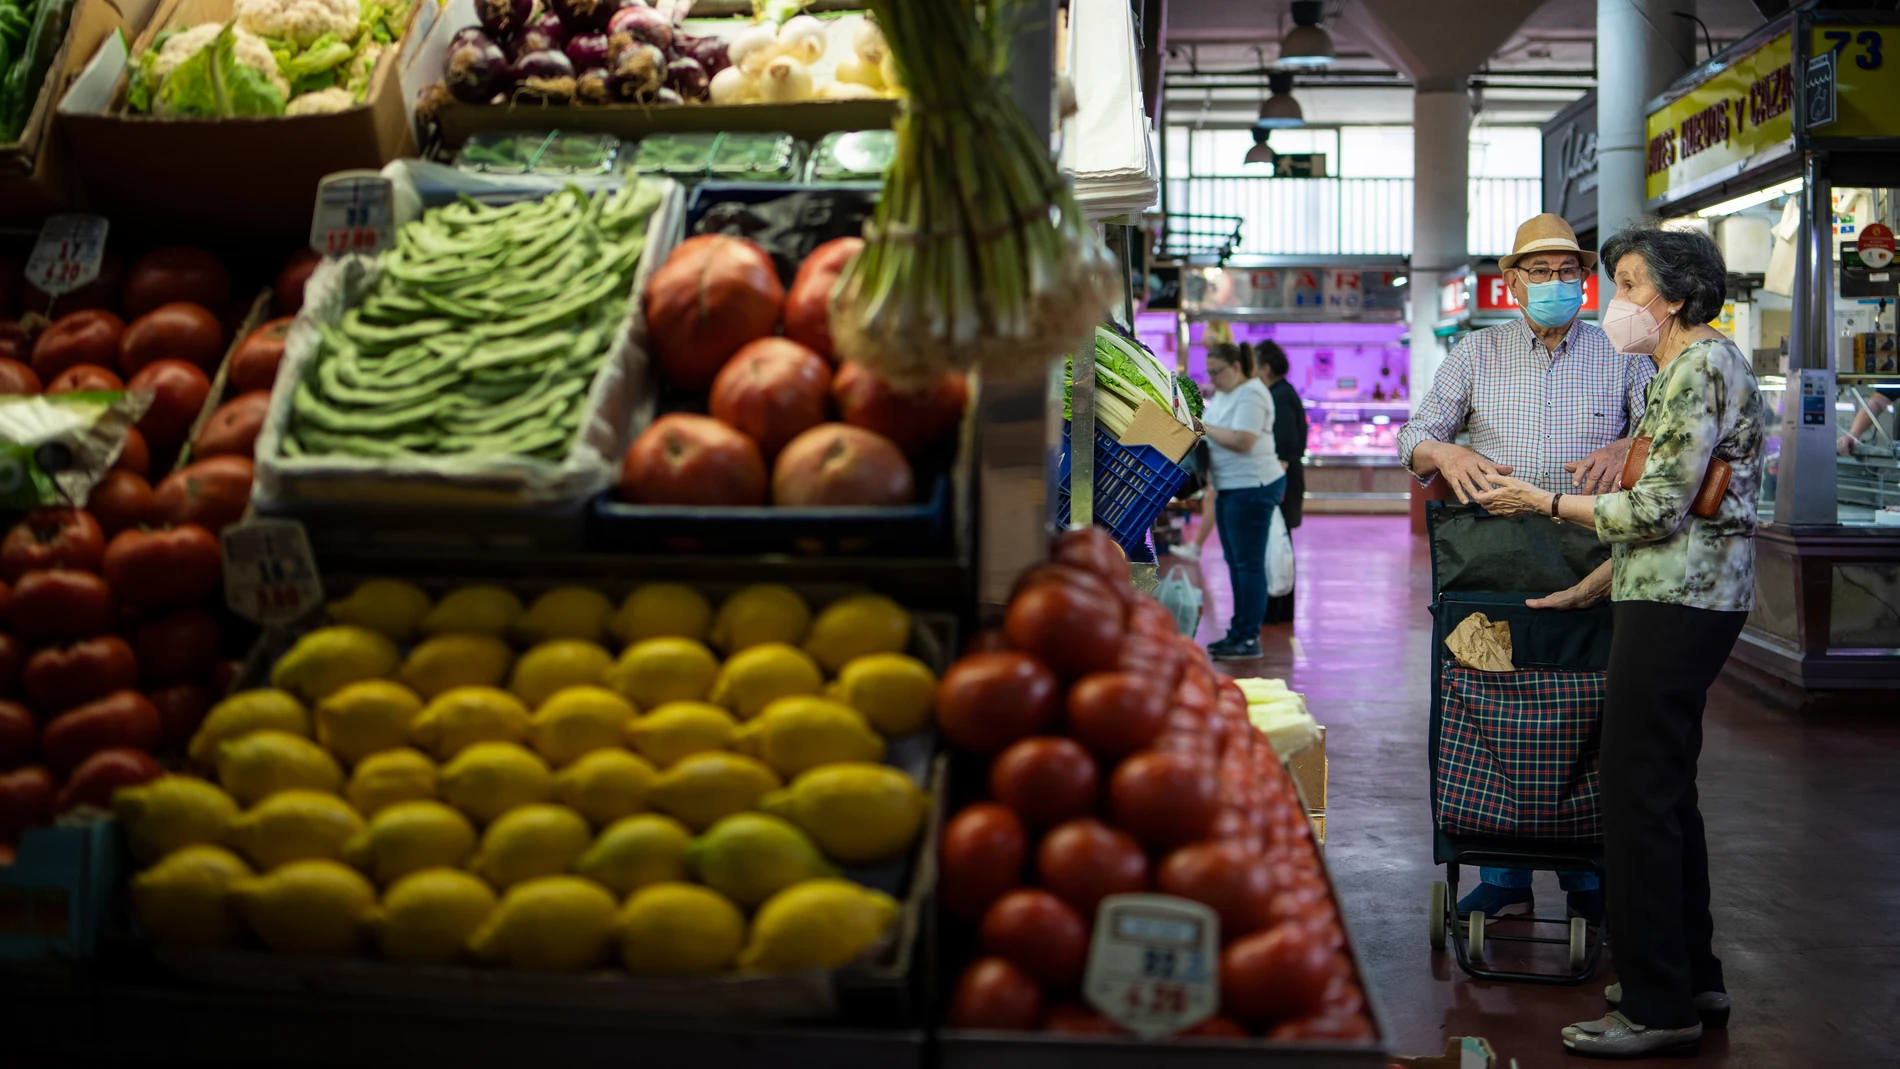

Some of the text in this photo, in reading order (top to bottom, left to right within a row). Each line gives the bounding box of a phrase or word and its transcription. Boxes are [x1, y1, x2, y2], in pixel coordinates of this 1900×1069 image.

[1824, 31, 1882, 70] 73
[1681, 99, 1729, 160] HUEVOS
[1734, 96, 1745, 133] Y
